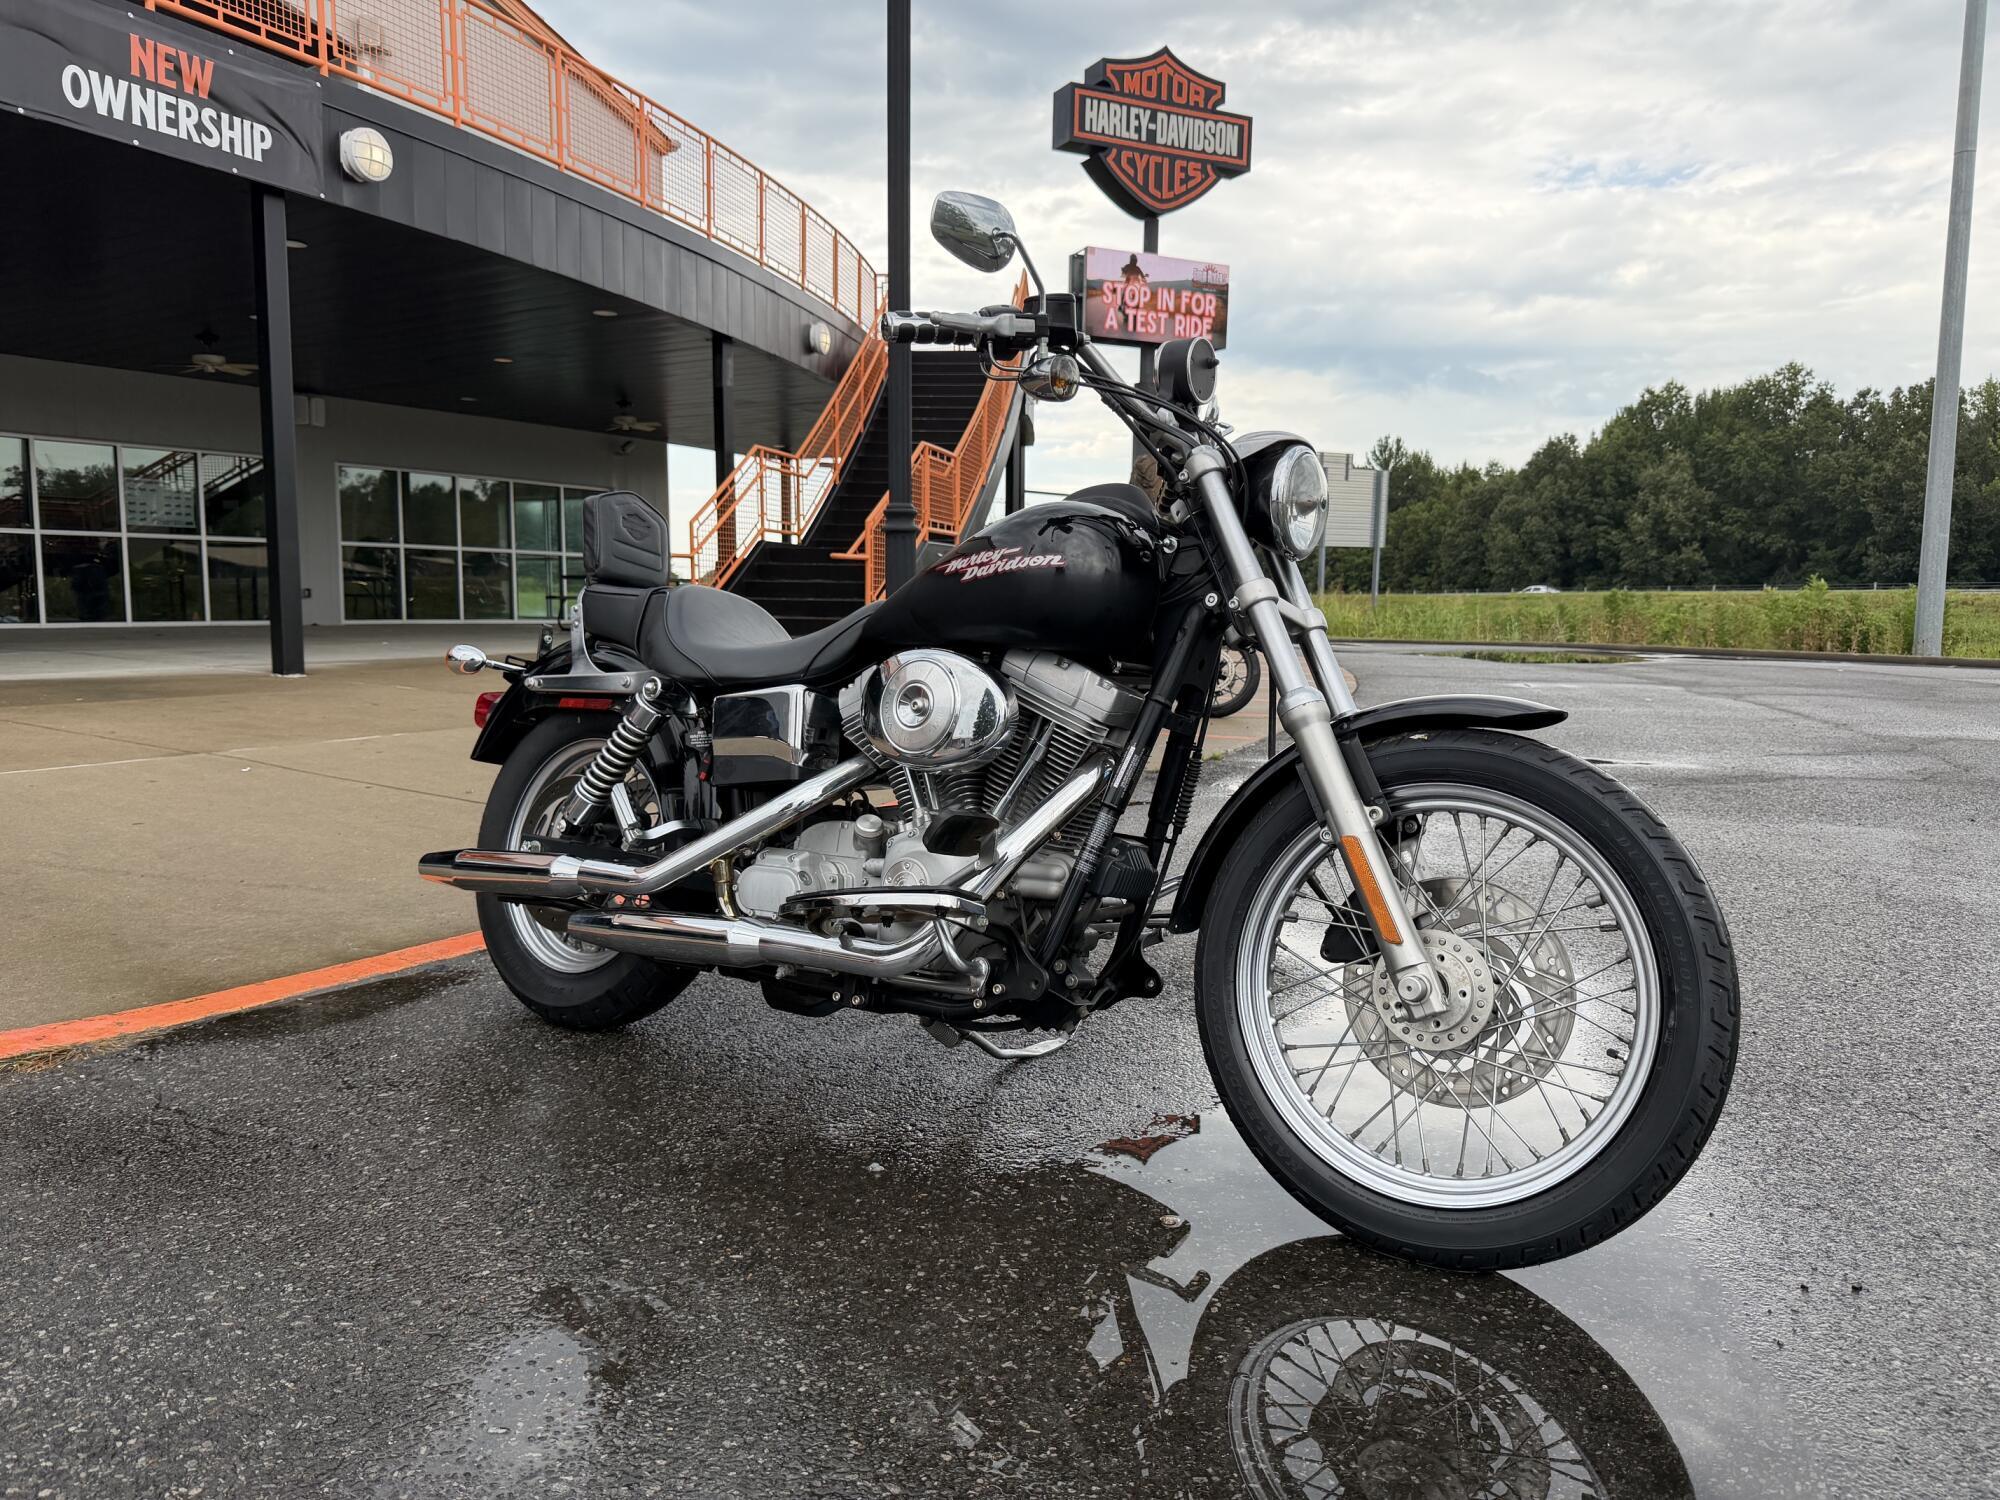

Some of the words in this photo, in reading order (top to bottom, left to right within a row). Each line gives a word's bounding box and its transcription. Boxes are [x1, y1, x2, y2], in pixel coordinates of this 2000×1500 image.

[129, 33, 215, 99] NEW
[1123, 64, 1206, 108] MOTOR
[61, 64, 273, 162] OWNERSHIP
[1085, 97, 1239, 157] HARLEY-DAVIDSON
[1120, 151, 1203, 199] CYCLES
[1102, 281, 1151, 308] STOP
[1157, 287, 1176, 312] IN
[1180, 290, 1217, 317] FOR
[1104, 307, 1119, 331] A
[1125, 308, 1169, 335] TEST
[1174, 313, 1213, 341] RIDE
[960, 554, 1065, 581] Davidson
